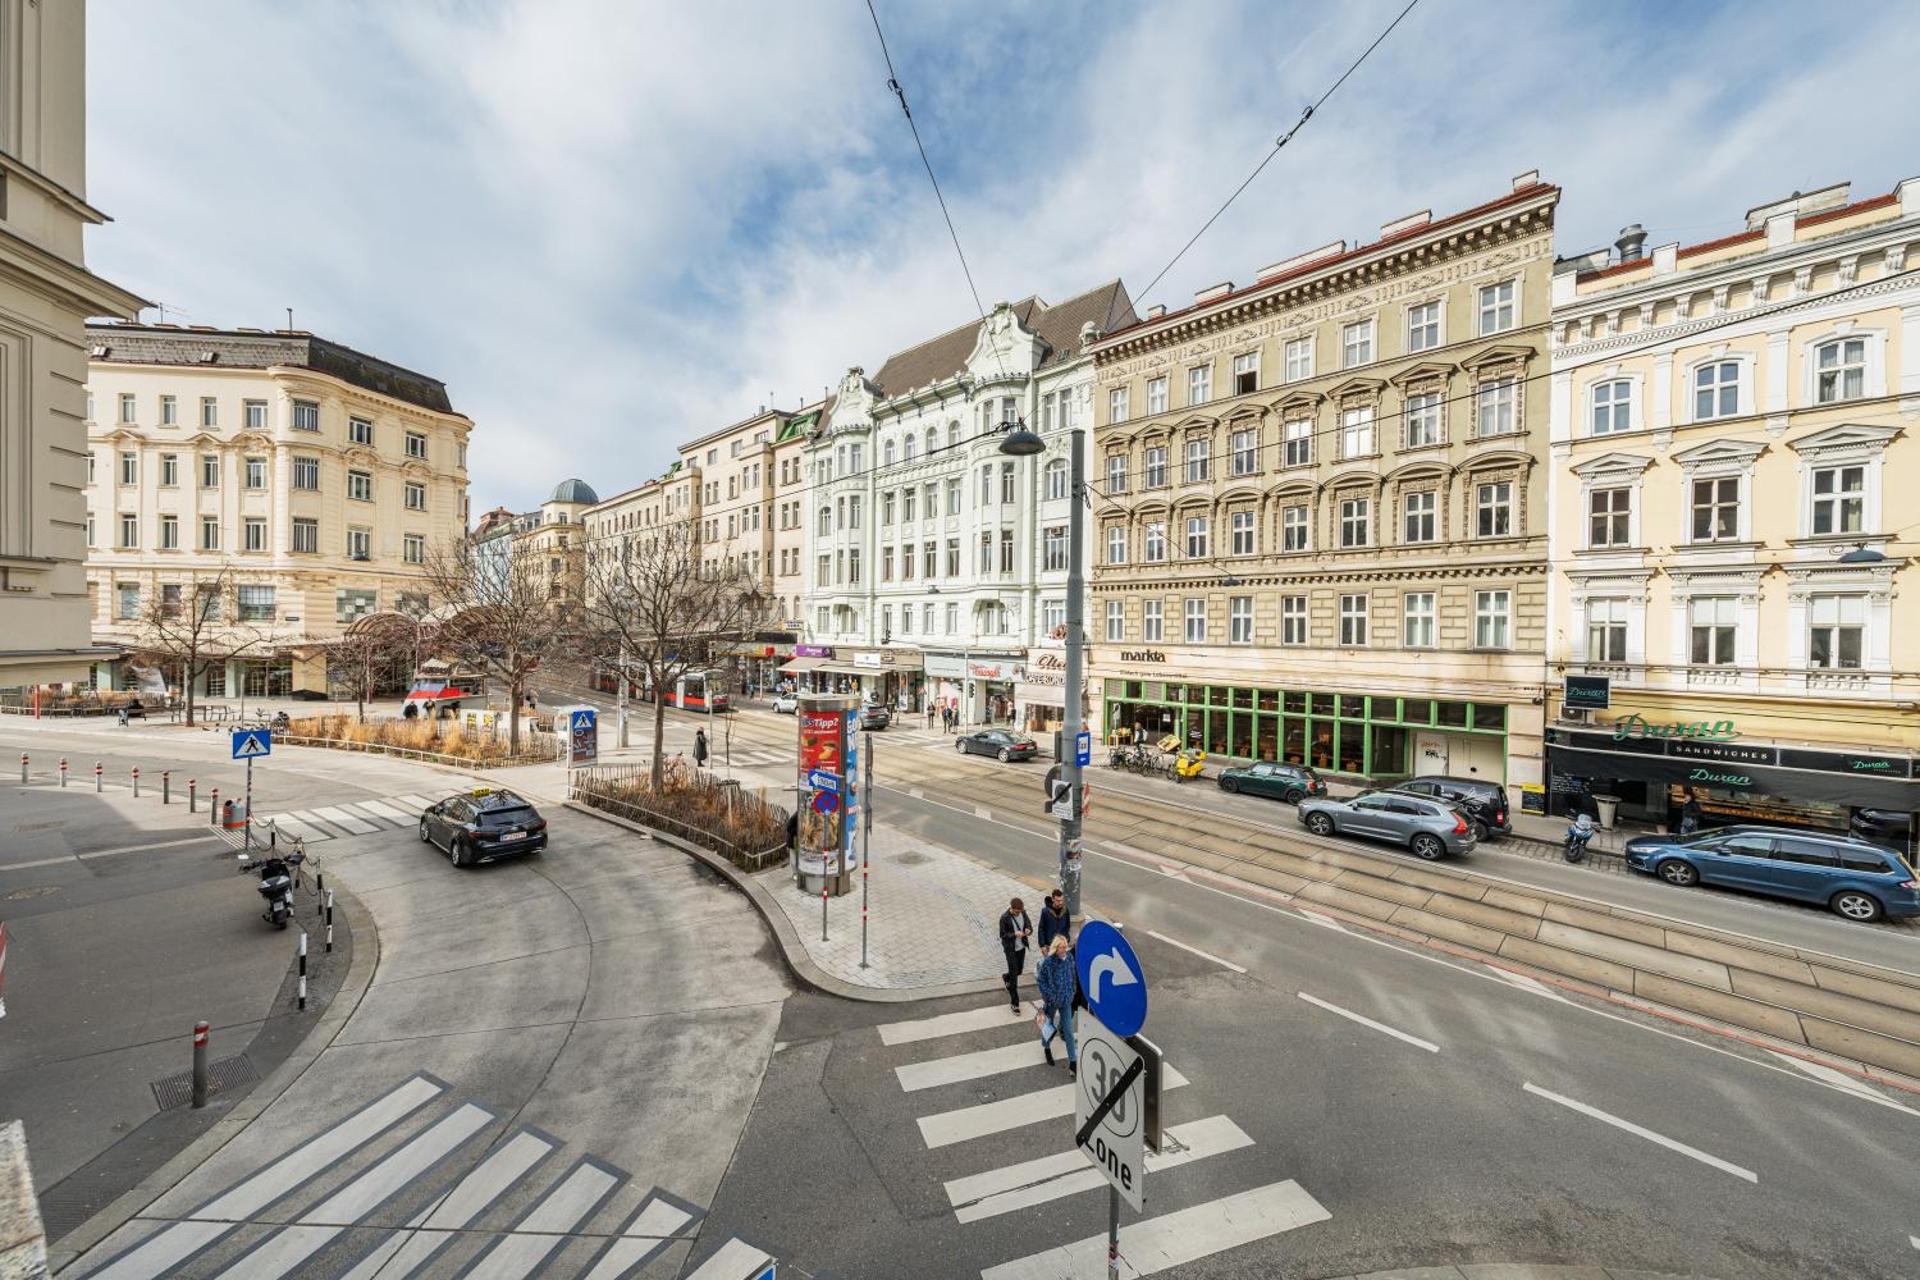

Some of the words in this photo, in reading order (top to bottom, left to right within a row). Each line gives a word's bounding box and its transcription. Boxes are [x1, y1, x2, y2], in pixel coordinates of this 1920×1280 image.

[1120, 649, 1166, 663] markta
[1568, 686, 1606, 698] Duran
[1612, 712, 1743, 742] Duran
[1676, 746, 1768, 760] SANDWICHES
[1853, 760, 1890, 769] Duran
[1689, 768, 1753, 786] Duran
[1091, 1051, 1126, 1123] 30
